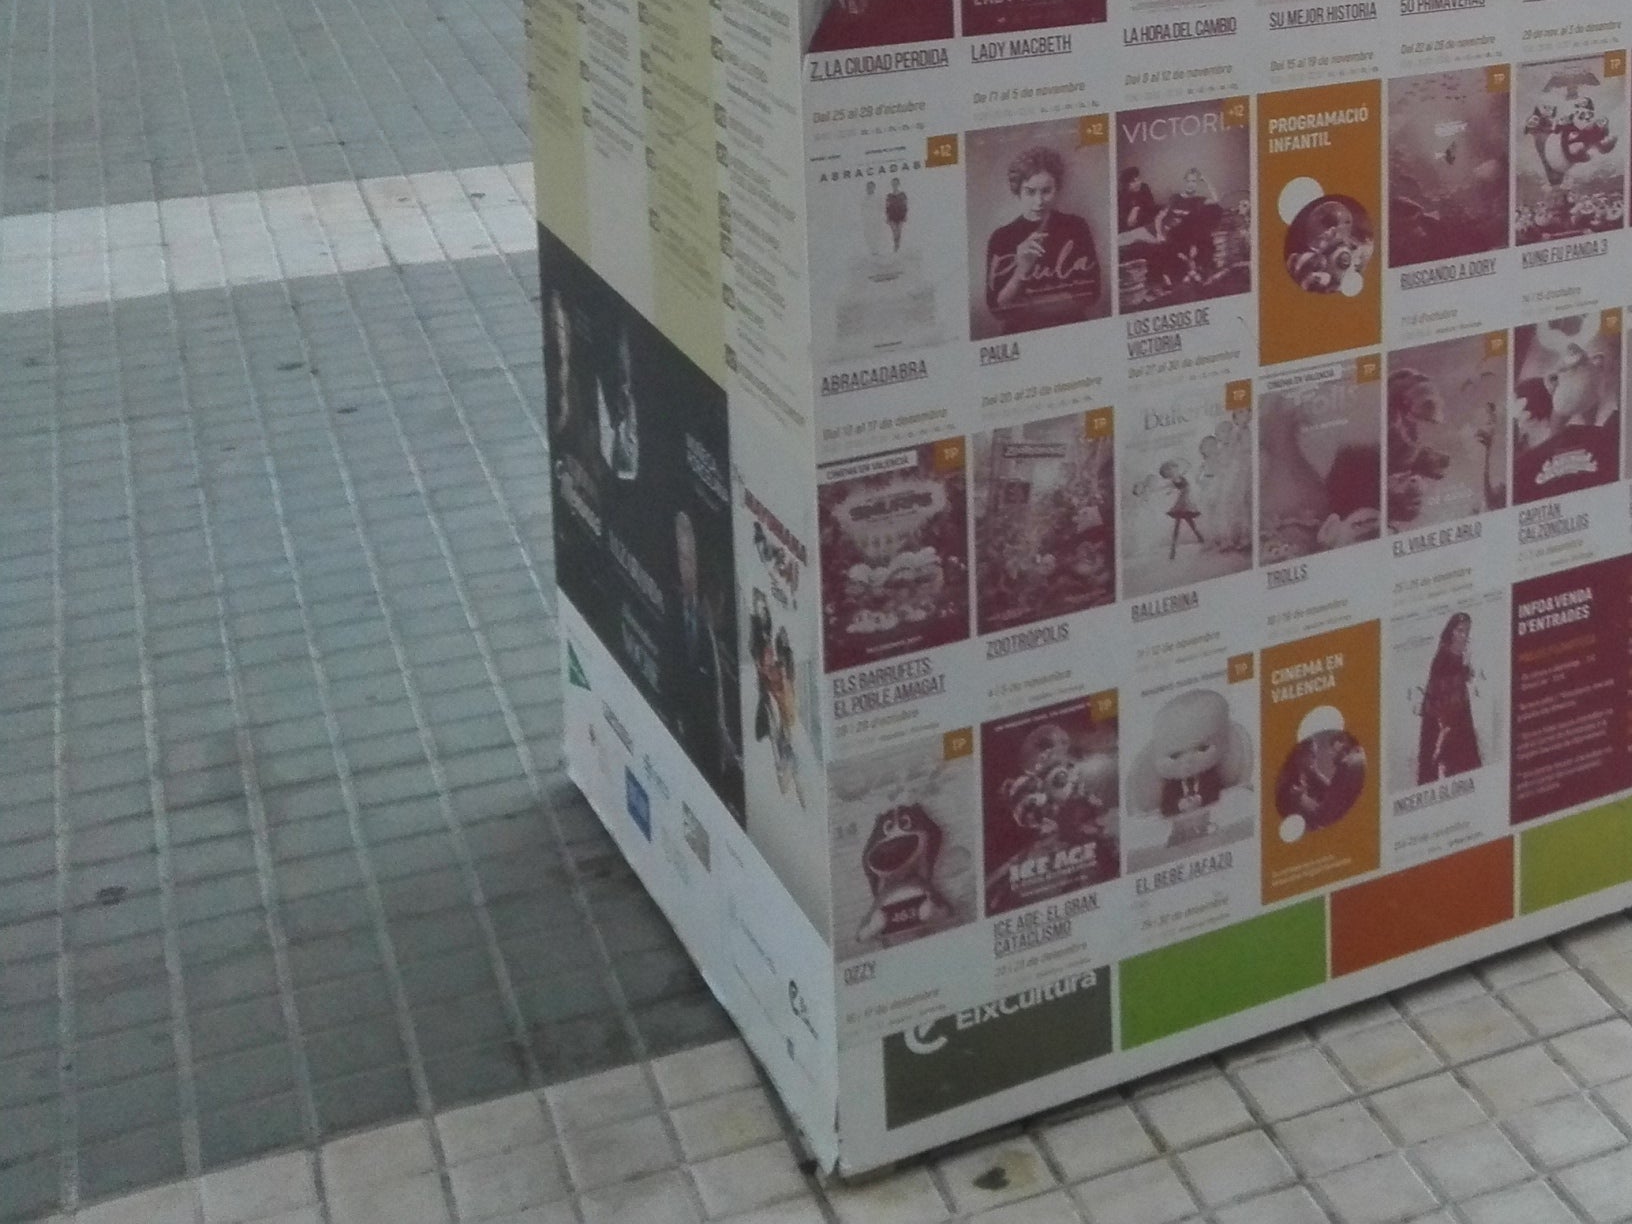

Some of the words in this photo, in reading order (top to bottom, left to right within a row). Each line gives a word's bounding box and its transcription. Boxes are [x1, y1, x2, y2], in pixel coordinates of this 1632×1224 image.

[1269, 12, 1284, 28] SU
[1287, 7, 1324, 25] MEJOR
[1326, 2, 1377, 21] HISTORIA
[1123, 27, 1138, 44] LA
[1141, 23, 1171, 42] HORA
[1172, 22, 1192, 38] DEL
[1195, 17, 1237, 36] CAMBIO
[971, 41, 1006, 61] LADY
[1010, 35, 1071, 56] MACBETH
[826, 59, 842, 77] LA
[845, 53, 891, 75] CIUDAD
[895, 48, 949, 69] PERDIDA
[1122, 113, 1225, 144] VICTORI
[1269, 103, 1368, 134] PROGRAMACIÓ
[1269, 132, 1331, 153] INFANTIL
[820, 160, 923, 183] ABRACADAB
[989, 240, 1093, 292] Pula
[1127, 318, 1150, 338] LOS
[1153, 310, 1191, 332] CASOS
[980, 342, 1020, 364] PAULA
[821, 360, 928, 395] ABRACADABRA
[1271, 658, 1323, 685] CINEMA
[1326, 652, 1344, 671] EN
